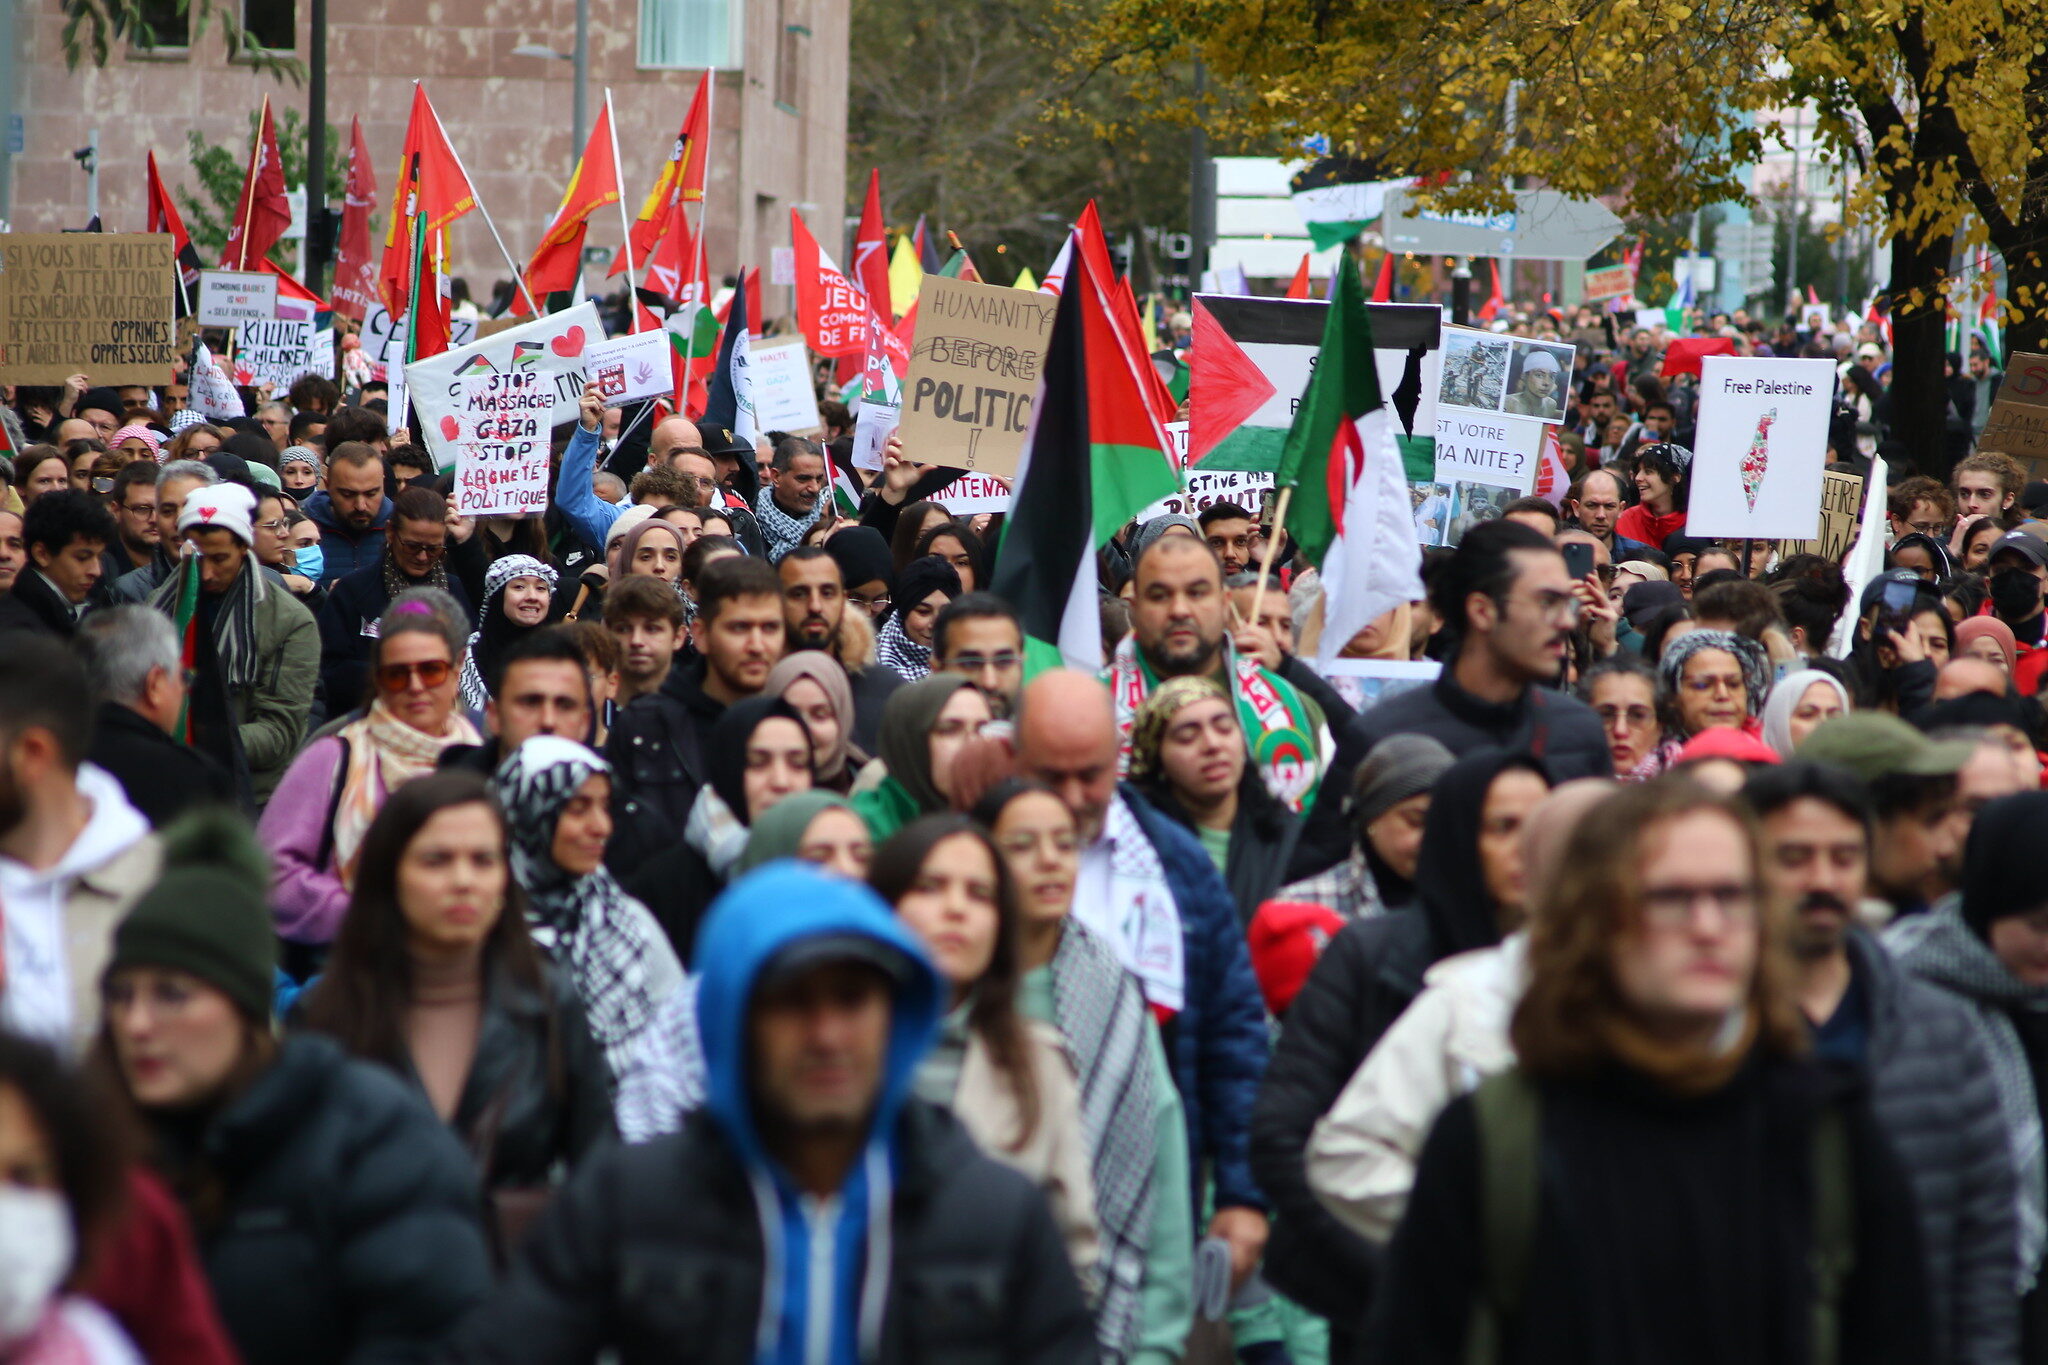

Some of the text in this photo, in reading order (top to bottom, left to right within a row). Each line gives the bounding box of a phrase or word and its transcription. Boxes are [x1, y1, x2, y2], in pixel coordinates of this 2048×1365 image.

[27, 244, 74, 268] VOUS
[80, 244, 103, 269] NE
[110, 243, 169, 268] FAITES
[9, 269, 40, 293] PAS
[52, 270, 162, 295] ATTENTION
[211, 282, 241, 292] BOMBING
[9, 295, 38, 318] LES
[94, 295, 126, 319] VOUS
[235, 296, 248, 304] NOT
[820, 288, 865, 311] JEU
[214, 308, 229, 316] SELF
[231, 308, 259, 317] DEFENSE
[820, 313, 865, 328] COMM
[820, 328, 842, 346] DE
[91, 344, 173, 365] OPPRESSEURS
[760, 351, 790, 363] HALTE
[931, 336, 1036, 381] BEFORE
[601, 363, 620, 375] STOP
[488, 372, 536, 391] STOP
[766, 375, 791, 386] GAZA
[1724, 378, 1813, 395] Free Palestine
[913, 377, 1034, 433] POLITIC
[476, 419, 537, 440] GAZA
[1458, 422, 1506, 441] VOTRE
[479, 442, 532, 461] STOP
